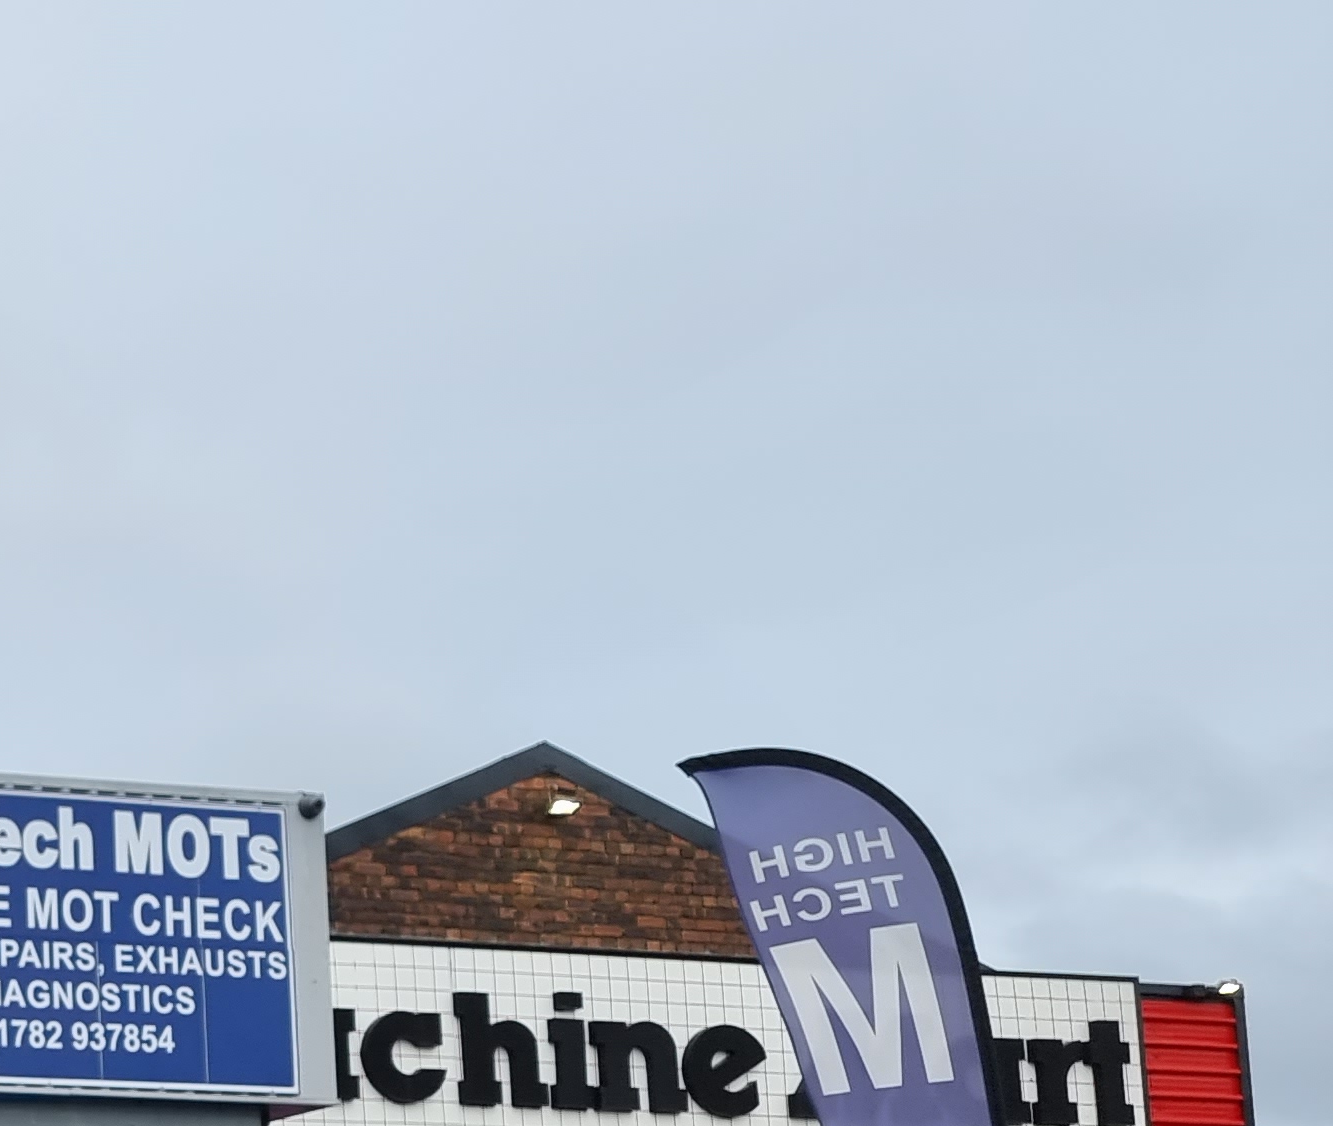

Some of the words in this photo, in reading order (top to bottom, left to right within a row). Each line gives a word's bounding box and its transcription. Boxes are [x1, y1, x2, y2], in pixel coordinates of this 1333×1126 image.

[113, 810, 281, 882] MOTs
[27, 887, 119, 933] MOT
[133, 893, 284, 942] CHECK
[114, 944, 287, 980] EXHAUSTS
[71, 1022, 176, 1054] 937854
[333, 992, 767, 1118] chine
